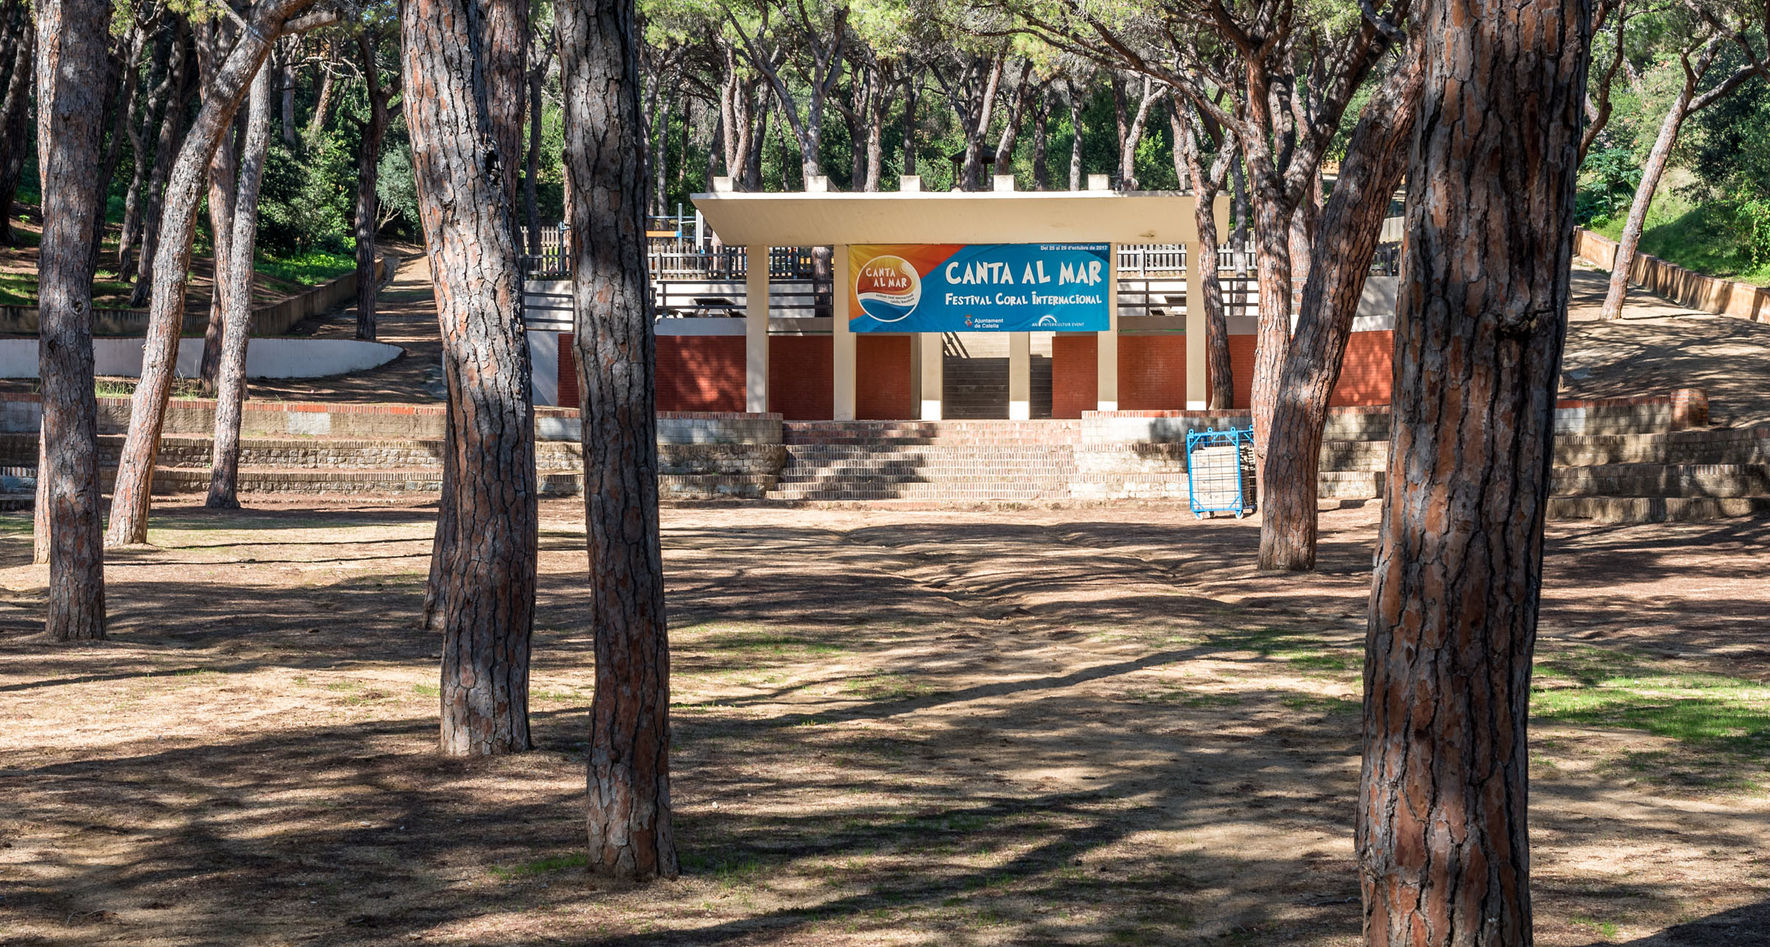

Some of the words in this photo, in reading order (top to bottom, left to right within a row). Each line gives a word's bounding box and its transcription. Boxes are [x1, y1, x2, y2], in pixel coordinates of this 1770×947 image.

[865, 267, 896, 277] CANTA
[945, 261, 1014, 285] CANTA
[1021, 260, 1051, 284] AL
[1058, 260, 1102, 286] MAR
[873, 277, 886, 288] AL
[888, 277, 907, 288] MAR
[945, 293, 992, 305] FESTIVAL
[995, 292, 1028, 306] CORAL
[1031, 291, 1102, 306] INTERNACIONAL
